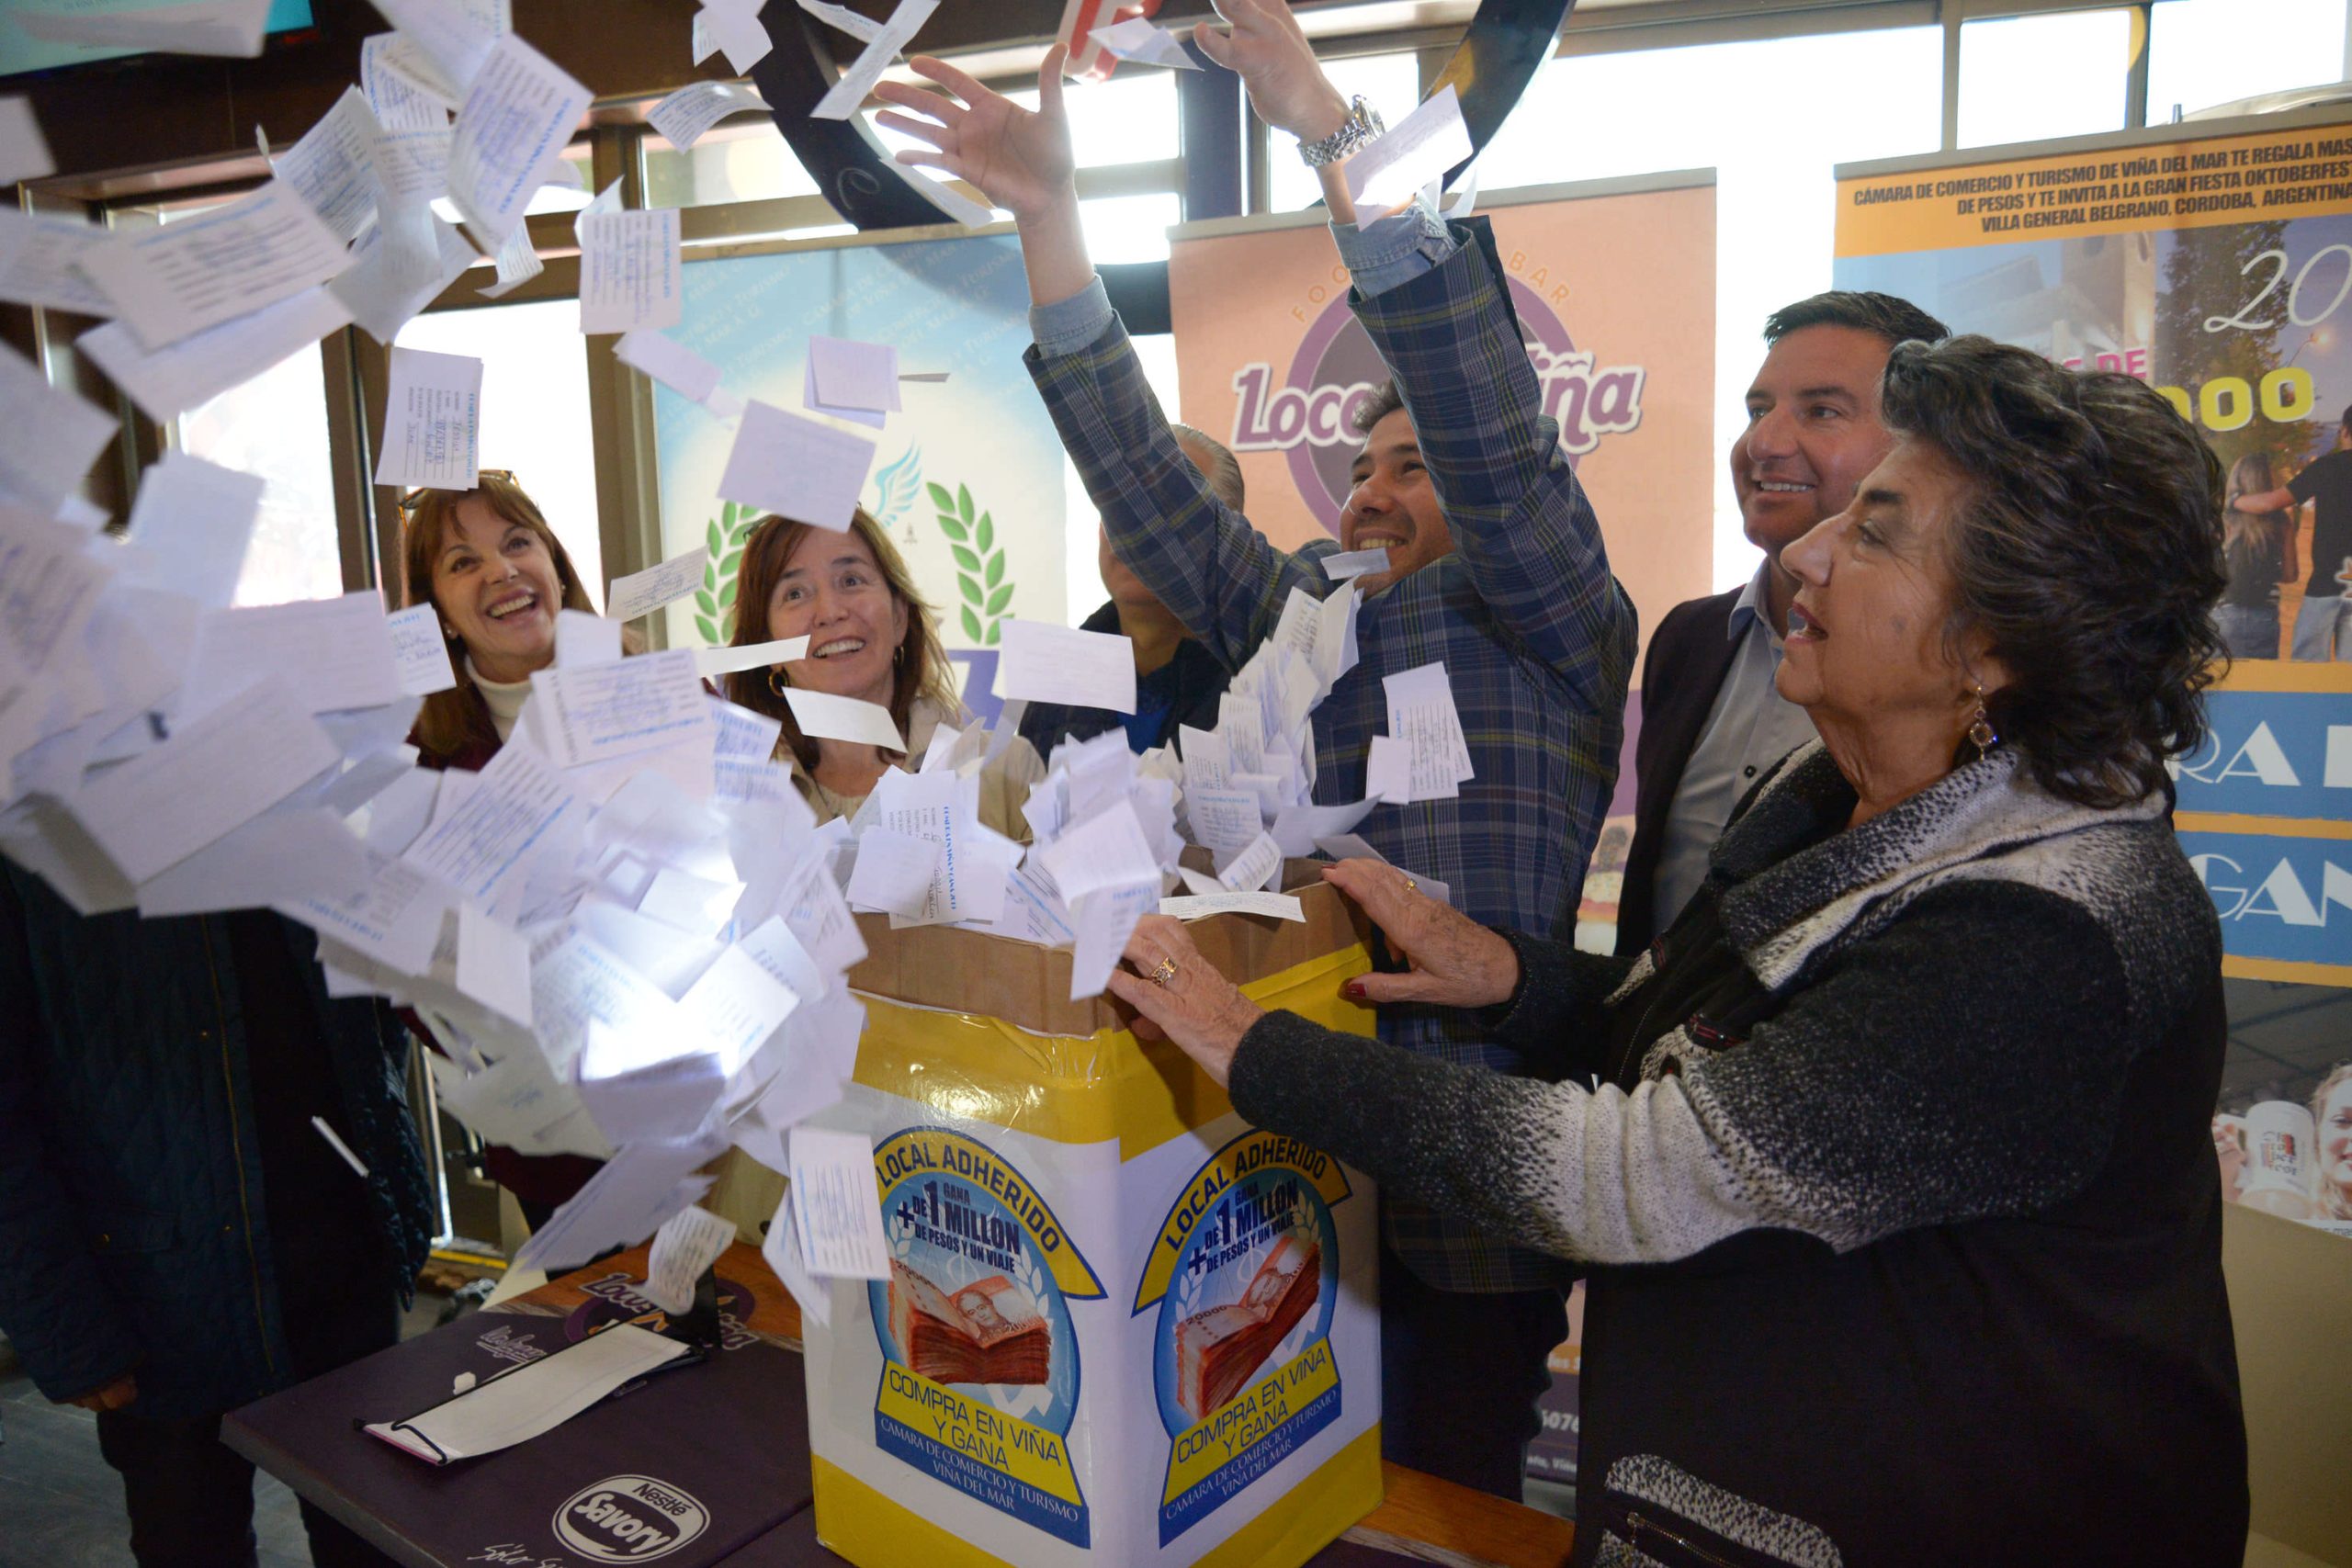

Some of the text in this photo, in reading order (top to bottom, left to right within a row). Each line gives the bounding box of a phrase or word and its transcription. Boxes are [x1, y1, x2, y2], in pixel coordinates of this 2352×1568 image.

[1854, 186, 1913, 206] CÁMARA
[1917, 182, 1933, 199] DE
[1936, 174, 2012, 198] COMERCIO
[2015, 174, 2026, 188] Y
[2028, 164, 2097, 187] TURISMO
[2099, 164, 2119, 180] DE
[2121, 156, 2158, 178] VIÑA
[2161, 155, 2188, 174] DEL
[2191, 152, 2228, 171] MAR
[2231, 148, 2250, 165] TE
[2252, 141, 2314, 164] REGALA
[1958, 160, 2352, 215] DE PESOS Y TE INVITA A LA GRAN FIESTA OKTOBERFES
[1982, 213, 2020, 233] VILLA
[2023, 206, 2086, 230] GENERAL
[2089, 199, 2172, 222] BELGRANO,
[2176, 192, 2256, 215] CORDOBA,
[1508, 250, 1570, 304] BAR
[876, 1142, 937, 1189] LOCAL
[942, 1145, 1060, 1253] ADHERIDO
[911, 1195, 928, 1218] DE
[923, 1180, 940, 1227] 1
[944, 1201, 1021, 1255] MILLON
[1165, 1137, 1327, 1251] LOCAL ADHERIDO
[1204, 1226, 1220, 1250] DE
[1216, 1198, 1231, 1246] 1
[1236, 1178, 1299, 1238] MILLON
[914, 1224, 1015, 1274] DE PESOS Y UN VIAJE
[1206, 1252, 1220, 1274] DE
[1220, 1236, 1250, 1266] PESOS
[1250, 1232, 1257, 1248] Y
[1258, 1225, 1271, 1245] UN
[889, 1370, 1061, 1467] COMPRA EN VIÑA
[1177, 1348, 1327, 1463] COMPRA EN VIÑA
[1223, 1400, 1289, 1457] Y GANA
[880, 1417, 1079, 1522] CAMARA DE COMERCIO Y TURISMO
[933, 1416, 1010, 1471] Y GANA
[1165, 1389, 1337, 1520] CAMARA DE COMERCIO Y TURISMO
[1221, 1438, 1292, 1496] VIÑA DEL MAR
[632, 1483, 693, 1517] Nestlé
[933, 1460, 1014, 1511] VIÑA DEL MAR
[574, 1493, 672, 1554] Savory
